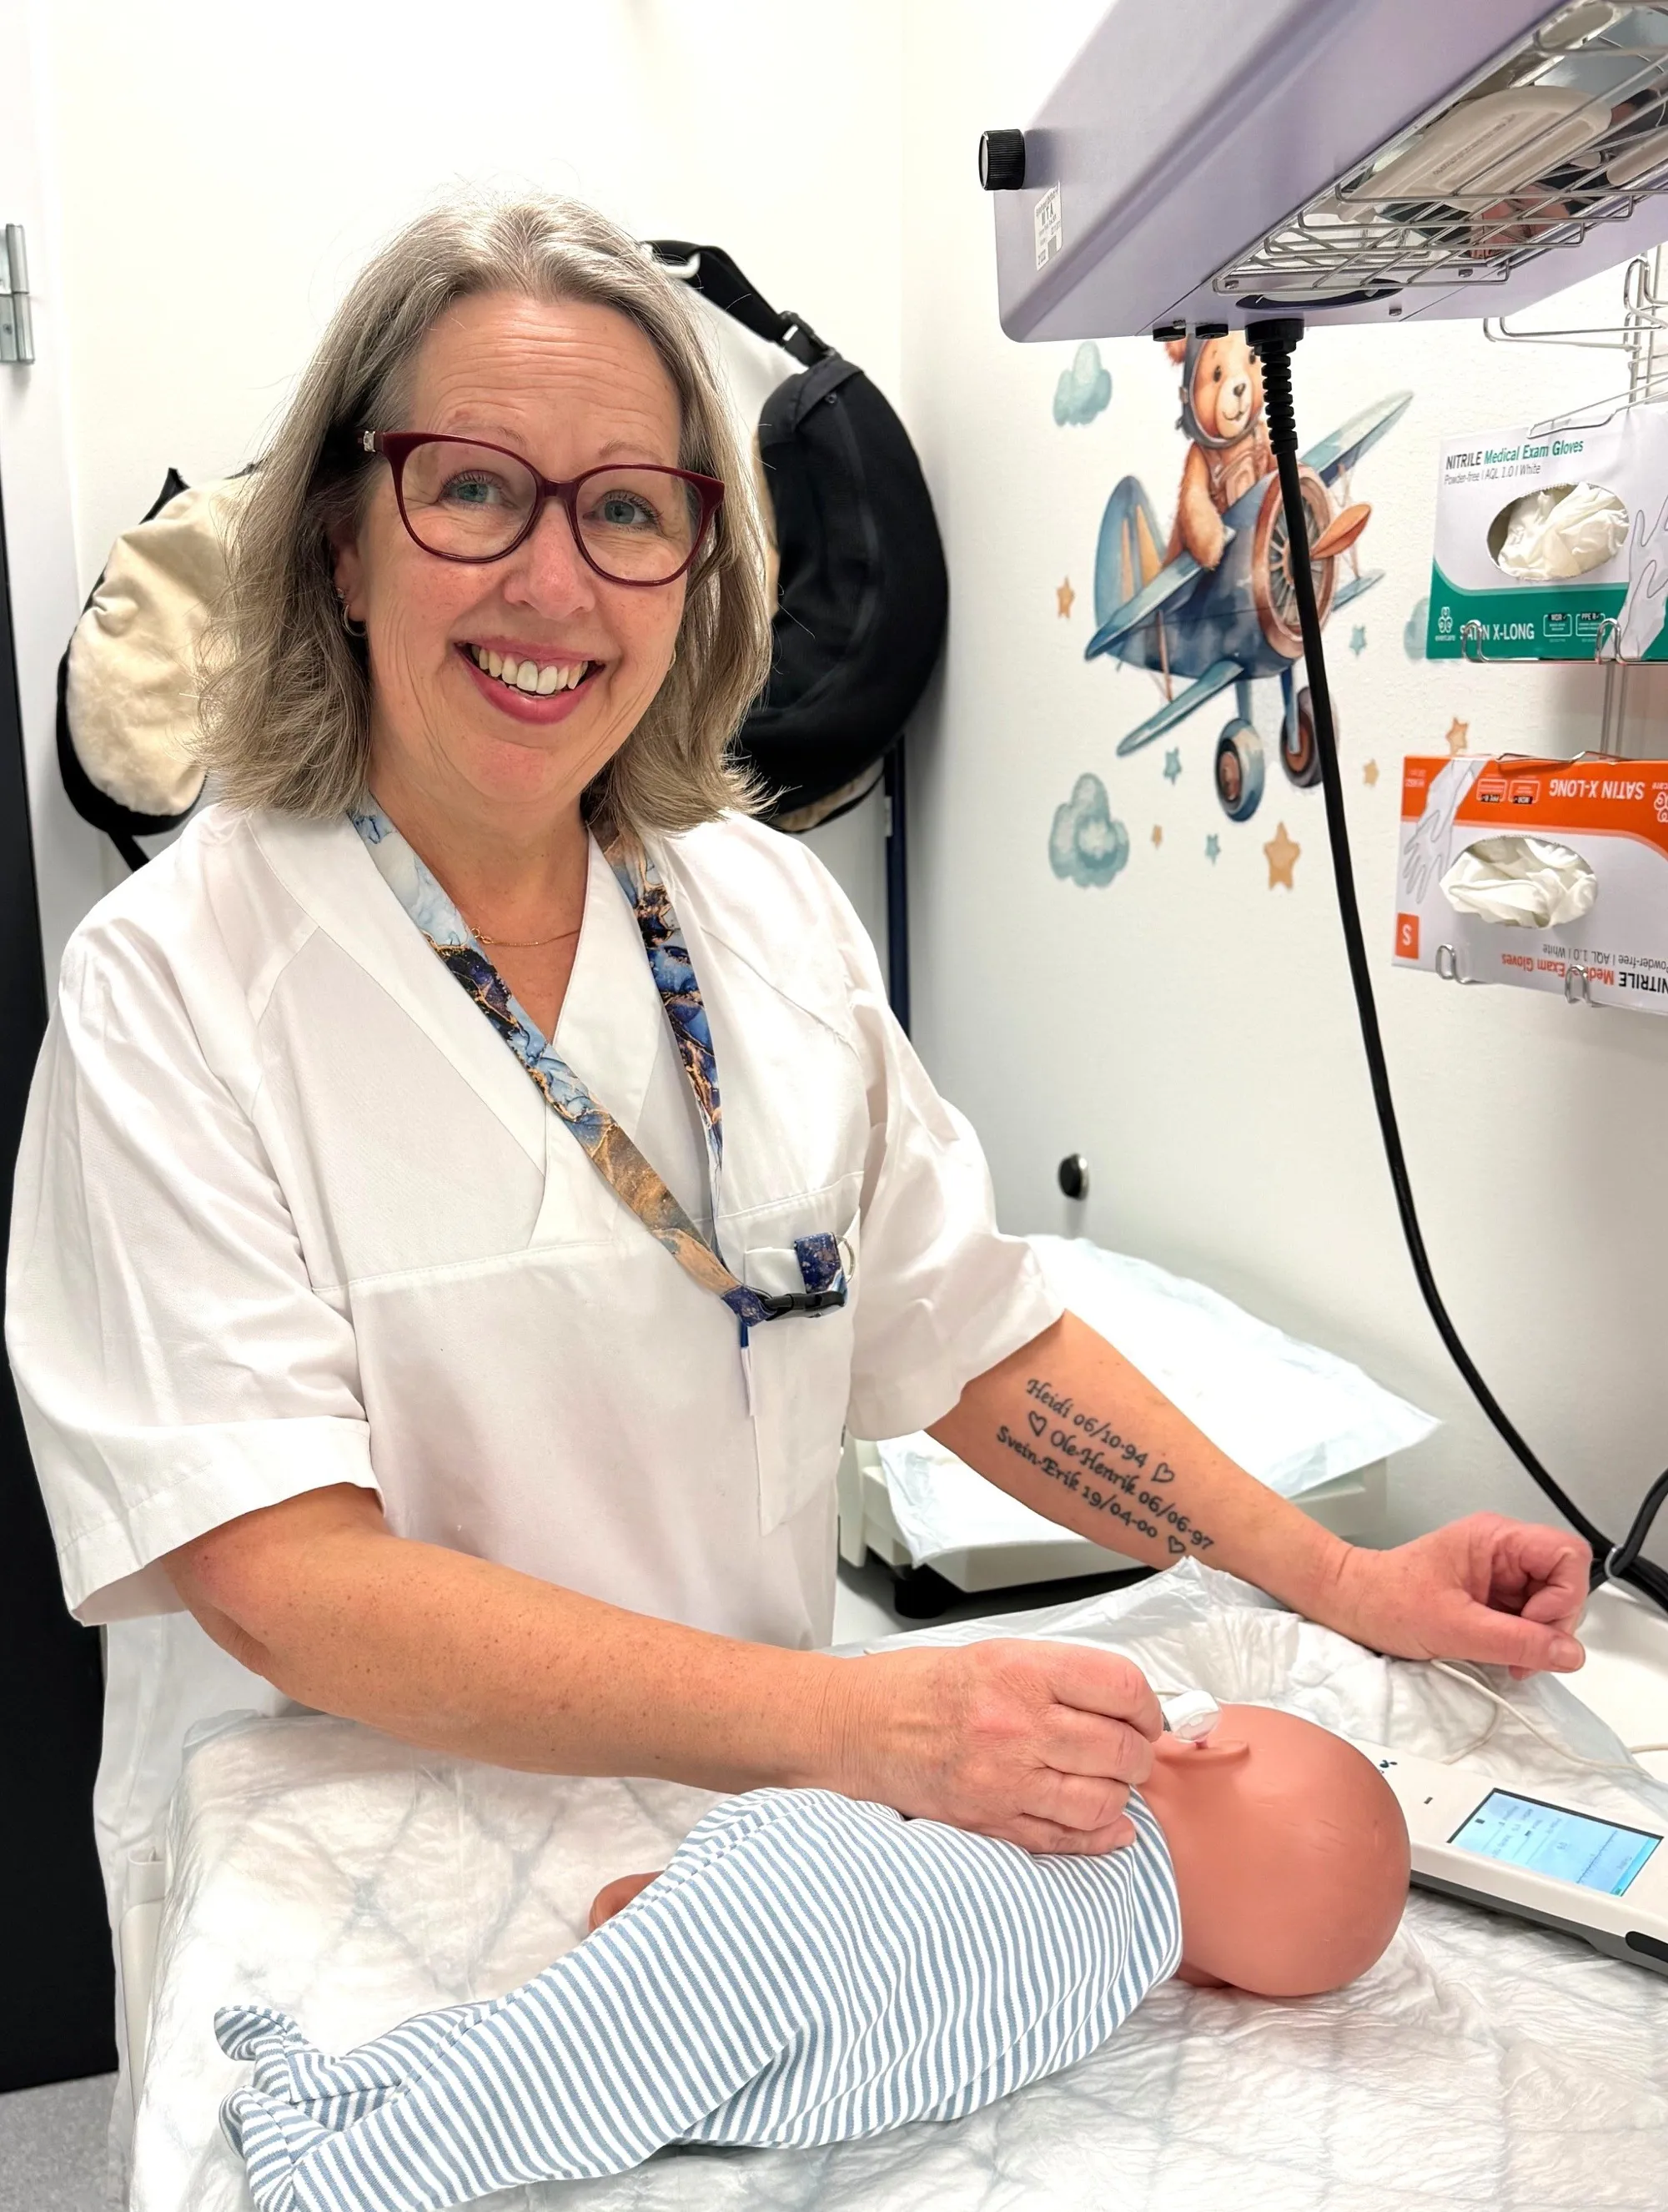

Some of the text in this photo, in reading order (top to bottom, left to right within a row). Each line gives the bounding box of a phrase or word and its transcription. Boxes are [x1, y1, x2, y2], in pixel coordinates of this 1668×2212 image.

[1445, 440, 1584, 470] NITRILE Medical Exam Gloves
[1520, 463, 1541, 475] White
[1493, 623, 1535, 640] X-LONG
[1549, 778, 1645, 800] SATIN X-LONG
[1403, 923, 1411, 946] S
[1543, 943, 1565, 958] White
[1573, 948, 1588, 961] 1.0
[1591, 950, 1610, 965] AQL
[1501, 953, 1535, 972] Gloves
[1537, 958, 1565, 978] Exam
[1027, 1379, 1073, 1418] Heidi
[1050, 1430, 1214, 1550] Ole-Henrik 06/06-97
[1082, 1486, 1158, 1539] 19/04-00
